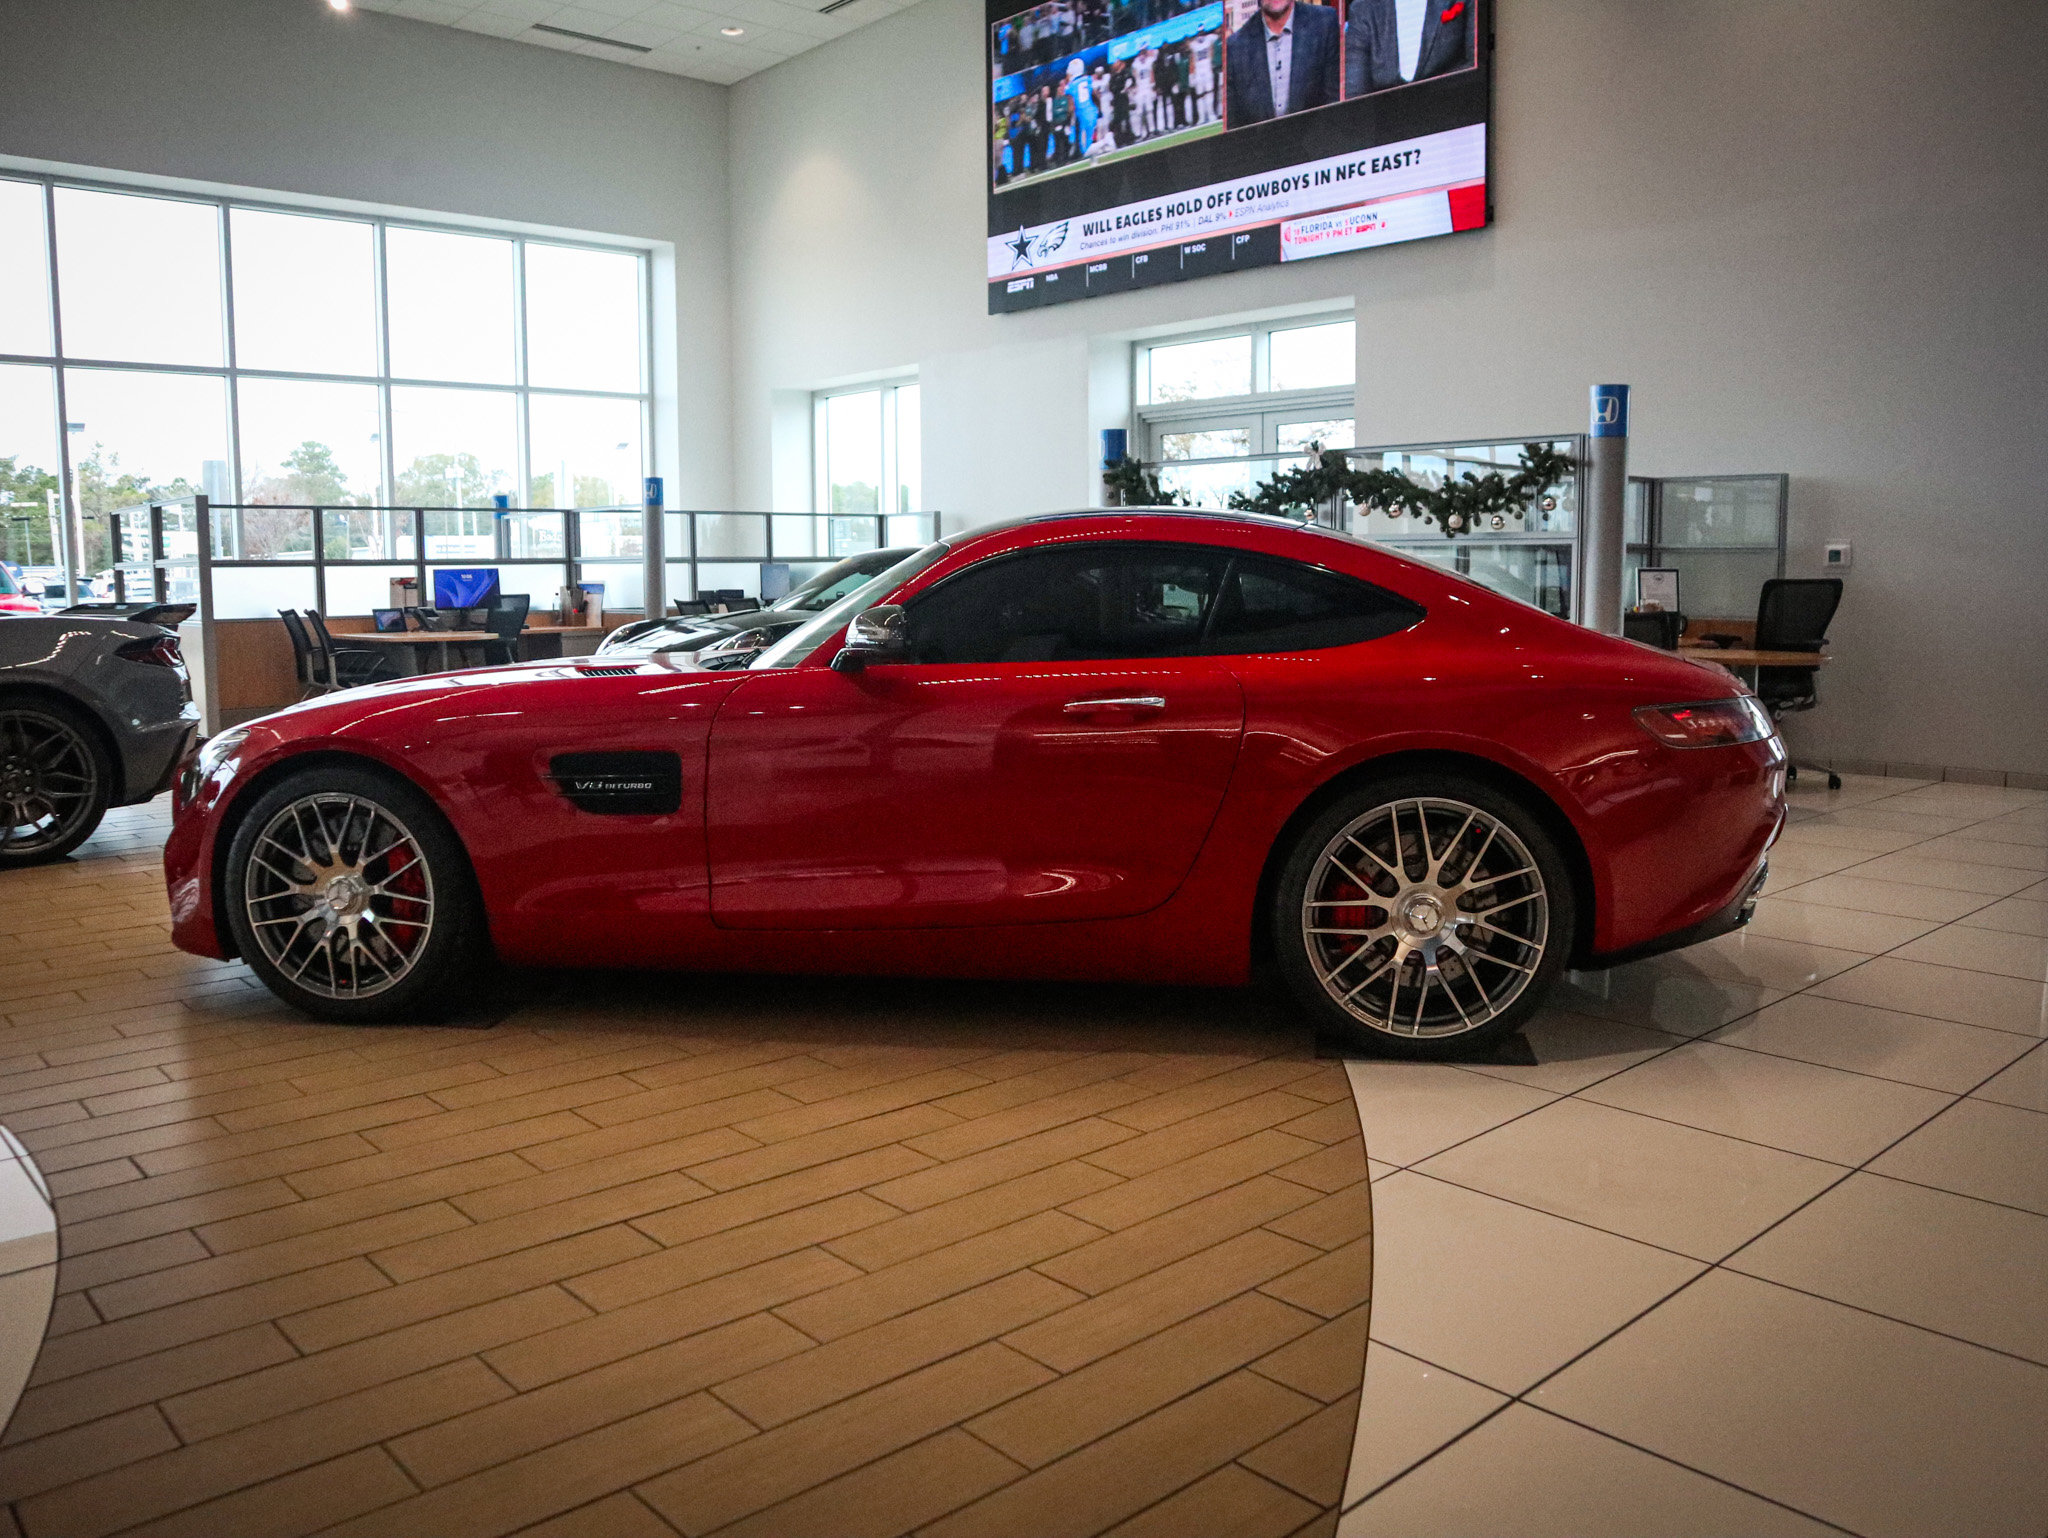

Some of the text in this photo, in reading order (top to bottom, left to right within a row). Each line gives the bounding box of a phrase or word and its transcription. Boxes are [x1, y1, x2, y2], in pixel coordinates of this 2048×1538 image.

[1083, 148, 1422, 237] WILL EAGLES HOLD OFF COWBOYS IN NFC EAST?
[1080, 238, 1108, 250] Chances
[1109, 236, 1117, 244] to
[1118, 233, 1130, 242] win
[1160, 222, 1174, 233] PHI
[1175, 219, 1191, 230] 91%
[1198, 214, 1213, 225] DAL
[1215, 211, 1227, 223] 9%
[1234, 205, 1255, 218] ESPN
[1257, 199, 1290, 213] Analytics
[1301, 221, 1333, 235] FLORIDA
[1349, 211, 1378, 225] UCONN
[1235, 234, 1251, 245] CFP
[1294, 232, 1324, 245] TONIGHT
[1332, 228, 1343, 238] PM
[1344, 226, 1353, 236] ET
[1184, 242, 1207, 255] W SOC
[1135, 254, 1149, 265] CFB
[1007, 277, 1034, 294] ESPN
[605, 782, 652, 790] BITURBO
